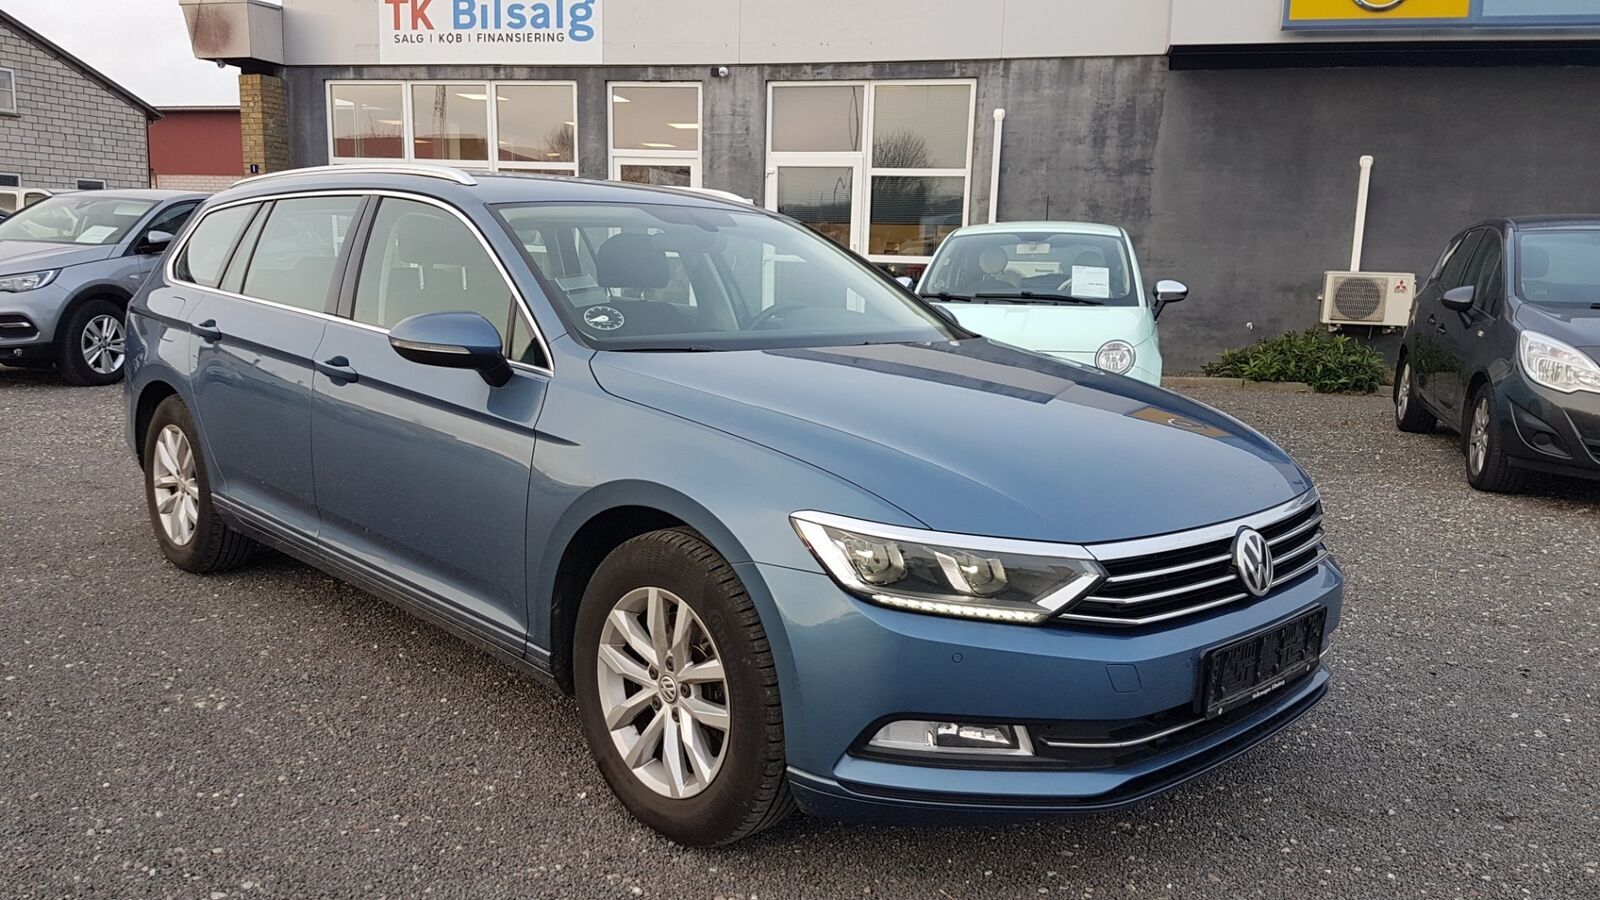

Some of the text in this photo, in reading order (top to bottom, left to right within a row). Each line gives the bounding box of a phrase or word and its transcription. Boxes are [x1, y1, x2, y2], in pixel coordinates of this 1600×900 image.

[384, 0, 595, 42] TK Bilsalg
[394, 34, 424, 43] SALG
[438, 32, 462, 44] KØB
[476, 32, 565, 43] FINANSIERING
